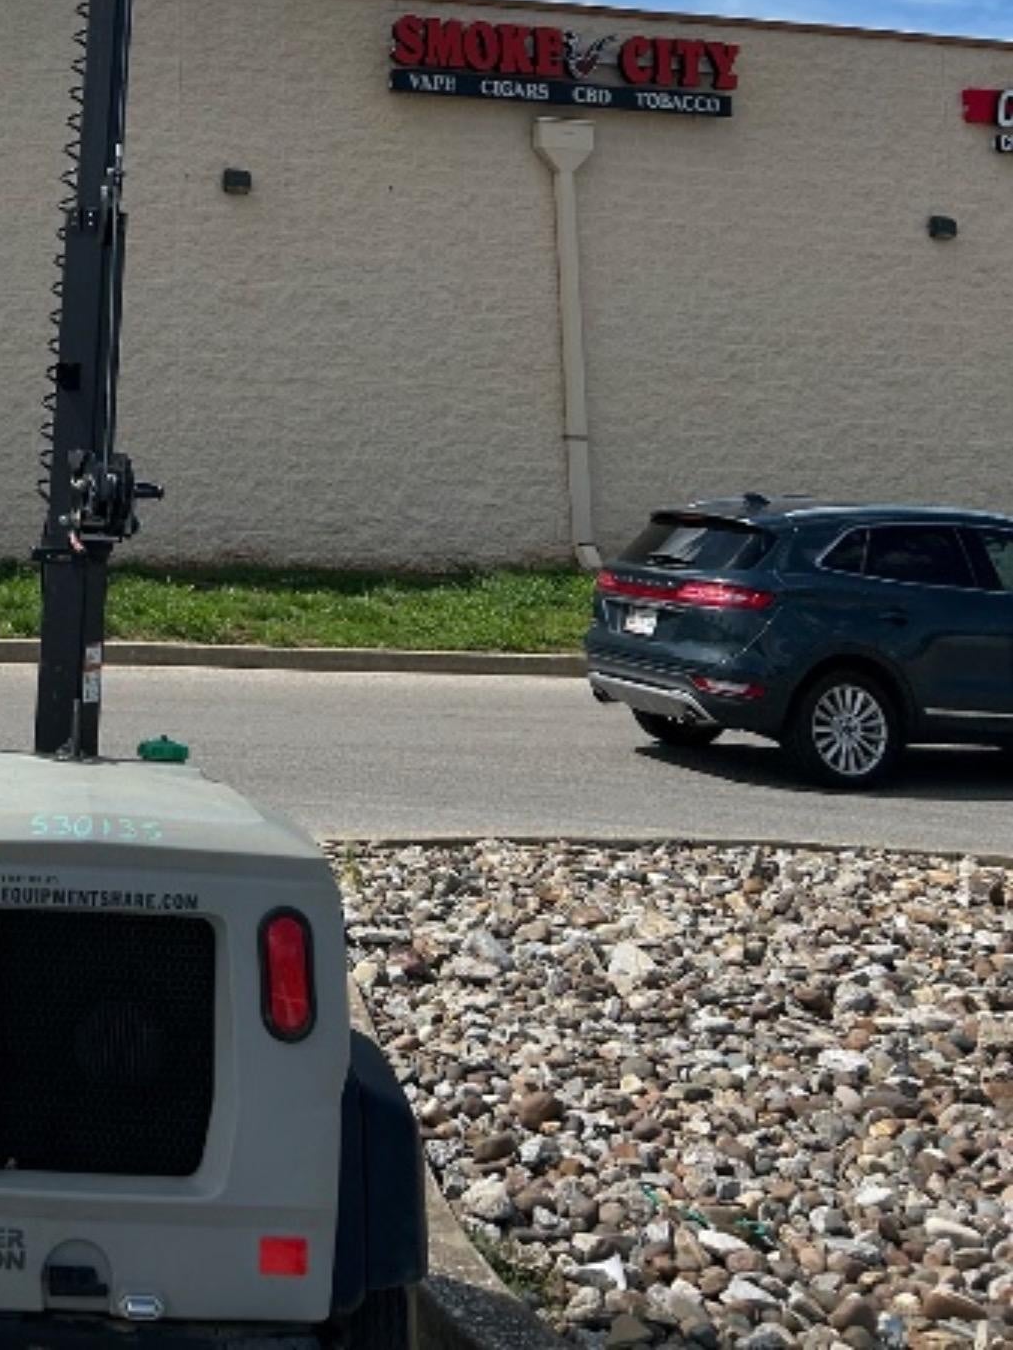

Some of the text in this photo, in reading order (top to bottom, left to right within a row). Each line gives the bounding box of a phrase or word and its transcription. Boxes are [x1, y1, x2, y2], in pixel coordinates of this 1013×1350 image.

[391, 14, 740, 90] SMOKE CITY
[480, 79, 549, 100] CIGARS
[572, 86, 612, 105] CBD
[637, 91, 720, 113] TOBACCO
[0, 887, 198, 910] EQUIPMENTSHARE.COM
